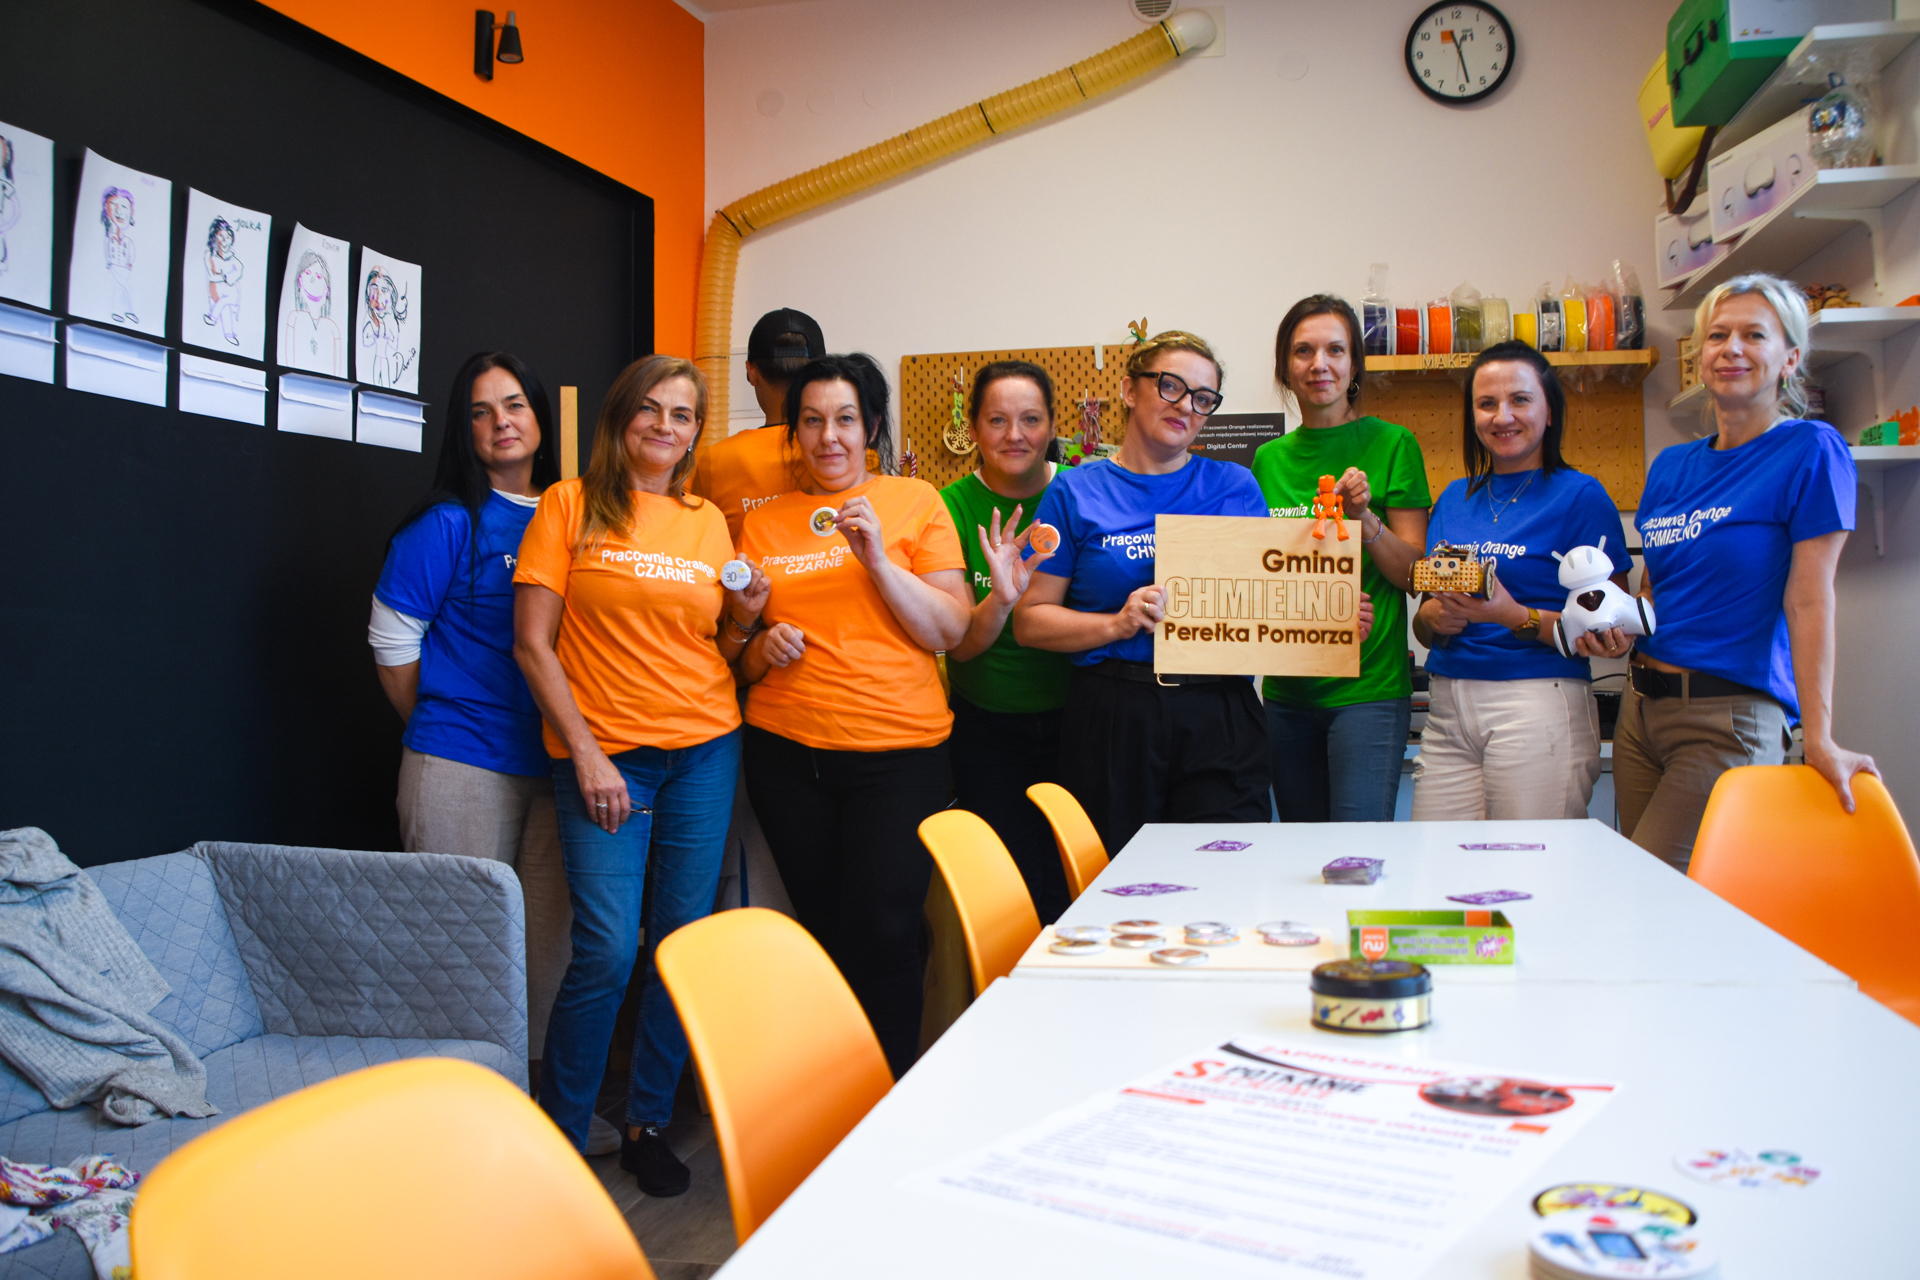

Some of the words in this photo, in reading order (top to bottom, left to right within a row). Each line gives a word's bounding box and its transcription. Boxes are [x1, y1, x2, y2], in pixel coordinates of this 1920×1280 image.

[1451, 10, 1461, 20] 12
[1435, 17, 1443, 26] 11
[1488, 25, 1496, 35] 2
[1421, 32, 1431, 41] 10
[1495, 43, 1503, 52] 3
[1416, 51, 1424, 60] 9
[1491, 62, 1498, 71] 4
[1424, 69, 1431, 78] 8
[1438, 80, 1445, 88] 7
[1479, 76, 1487, 85] 5
[1459, 84, 1466, 93] 6
[233, 218, 261, 231] JOLKA
[1206, 443, 1227, 451] Digital
[1644, 521, 1702, 549] CHMIELNO
[1480, 541, 1526, 559] Orange
[601, 549, 674, 567] Pracownia
[675, 557, 717, 579] Orange
[761, 551, 826, 568] Pracownia
[1262, 549, 1354, 574] Gmina
[785, 555, 844, 575] CZARNE
[634, 562, 696, 584] CZARNE
[725, 571, 737, 583] 30
[1164, 576, 1354, 622] CHMIELNO
[1164, 622, 1250, 642] Perełka
[1257, 624, 1353, 645] Pomorza
